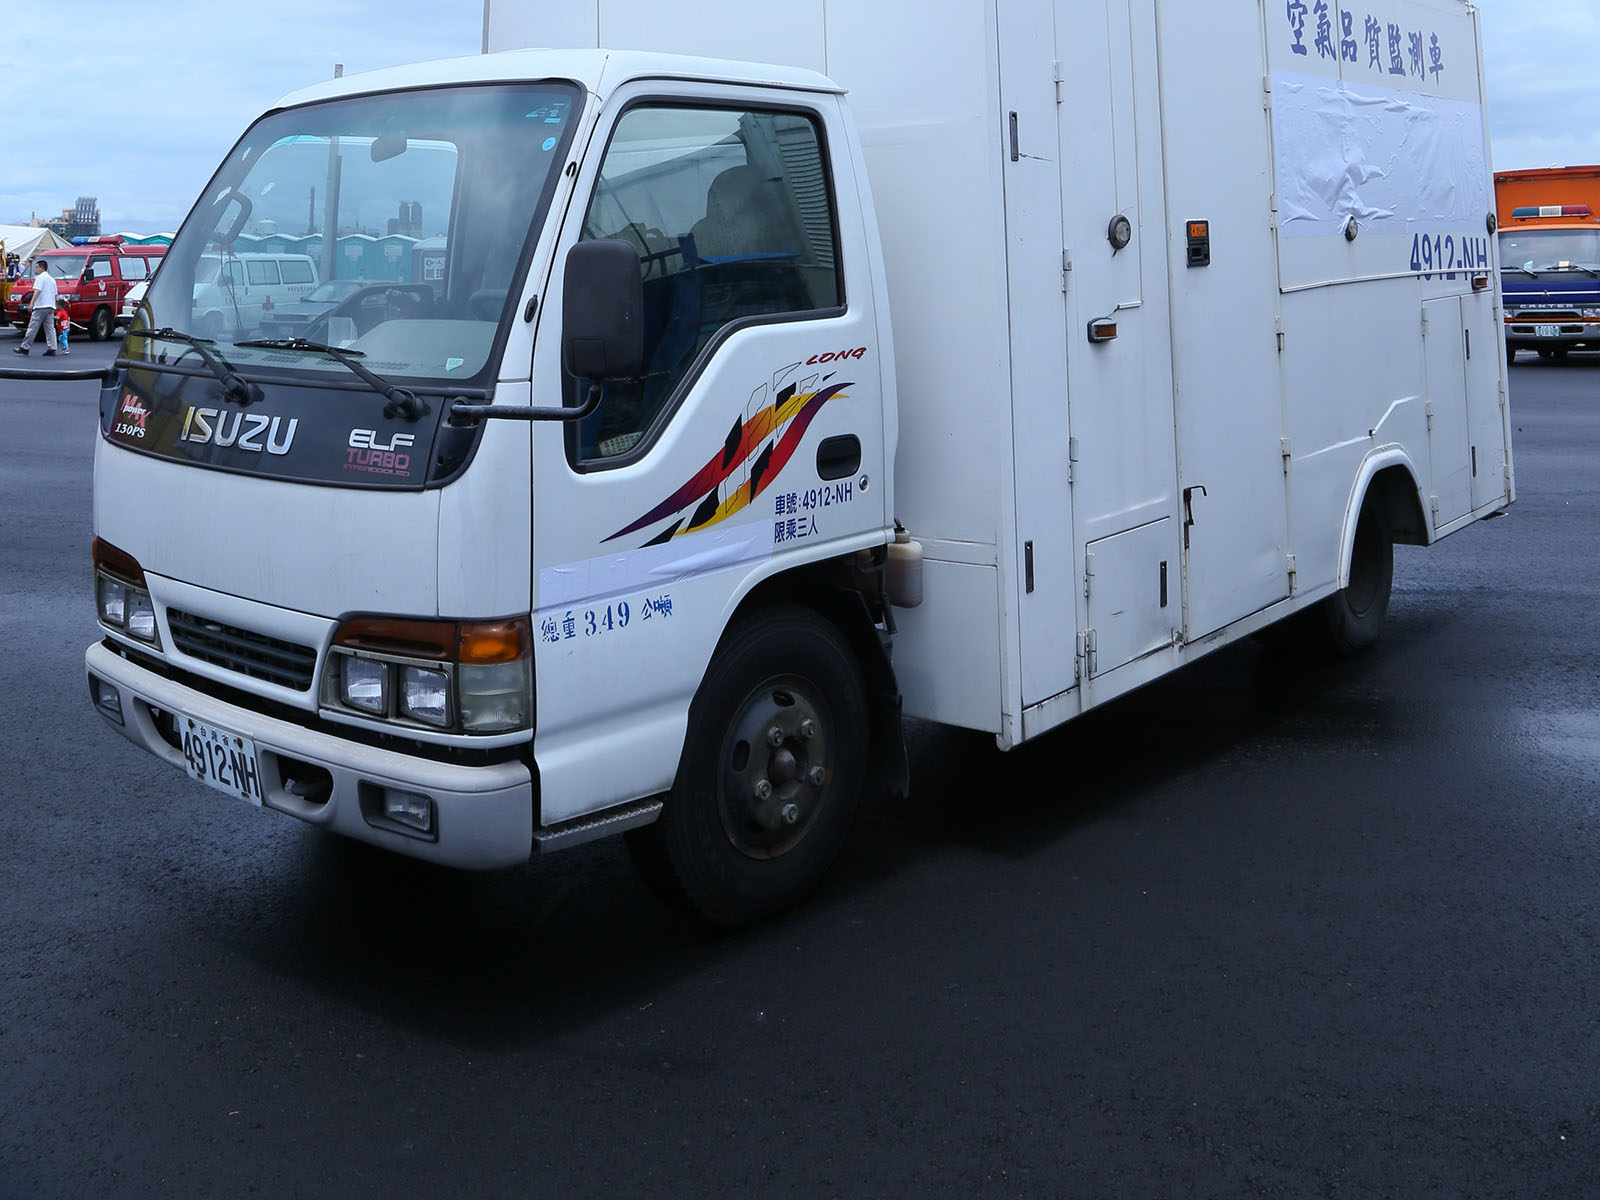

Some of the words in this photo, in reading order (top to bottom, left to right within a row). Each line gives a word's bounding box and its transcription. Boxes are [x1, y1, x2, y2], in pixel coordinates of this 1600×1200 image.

[1410, 233, 1488, 281] 4912-NH
[806, 347, 867, 365] LONG
[115, 423, 146, 438] 130PS
[181, 406, 299, 456] ISUZU
[349, 428, 416, 451] ELF
[347, 448, 410, 470] TURBO
[774, 515, 819, 544] 限乘三人
[584, 601, 631, 637] 3.49
[184, 731, 260, 798] 4912-NH
